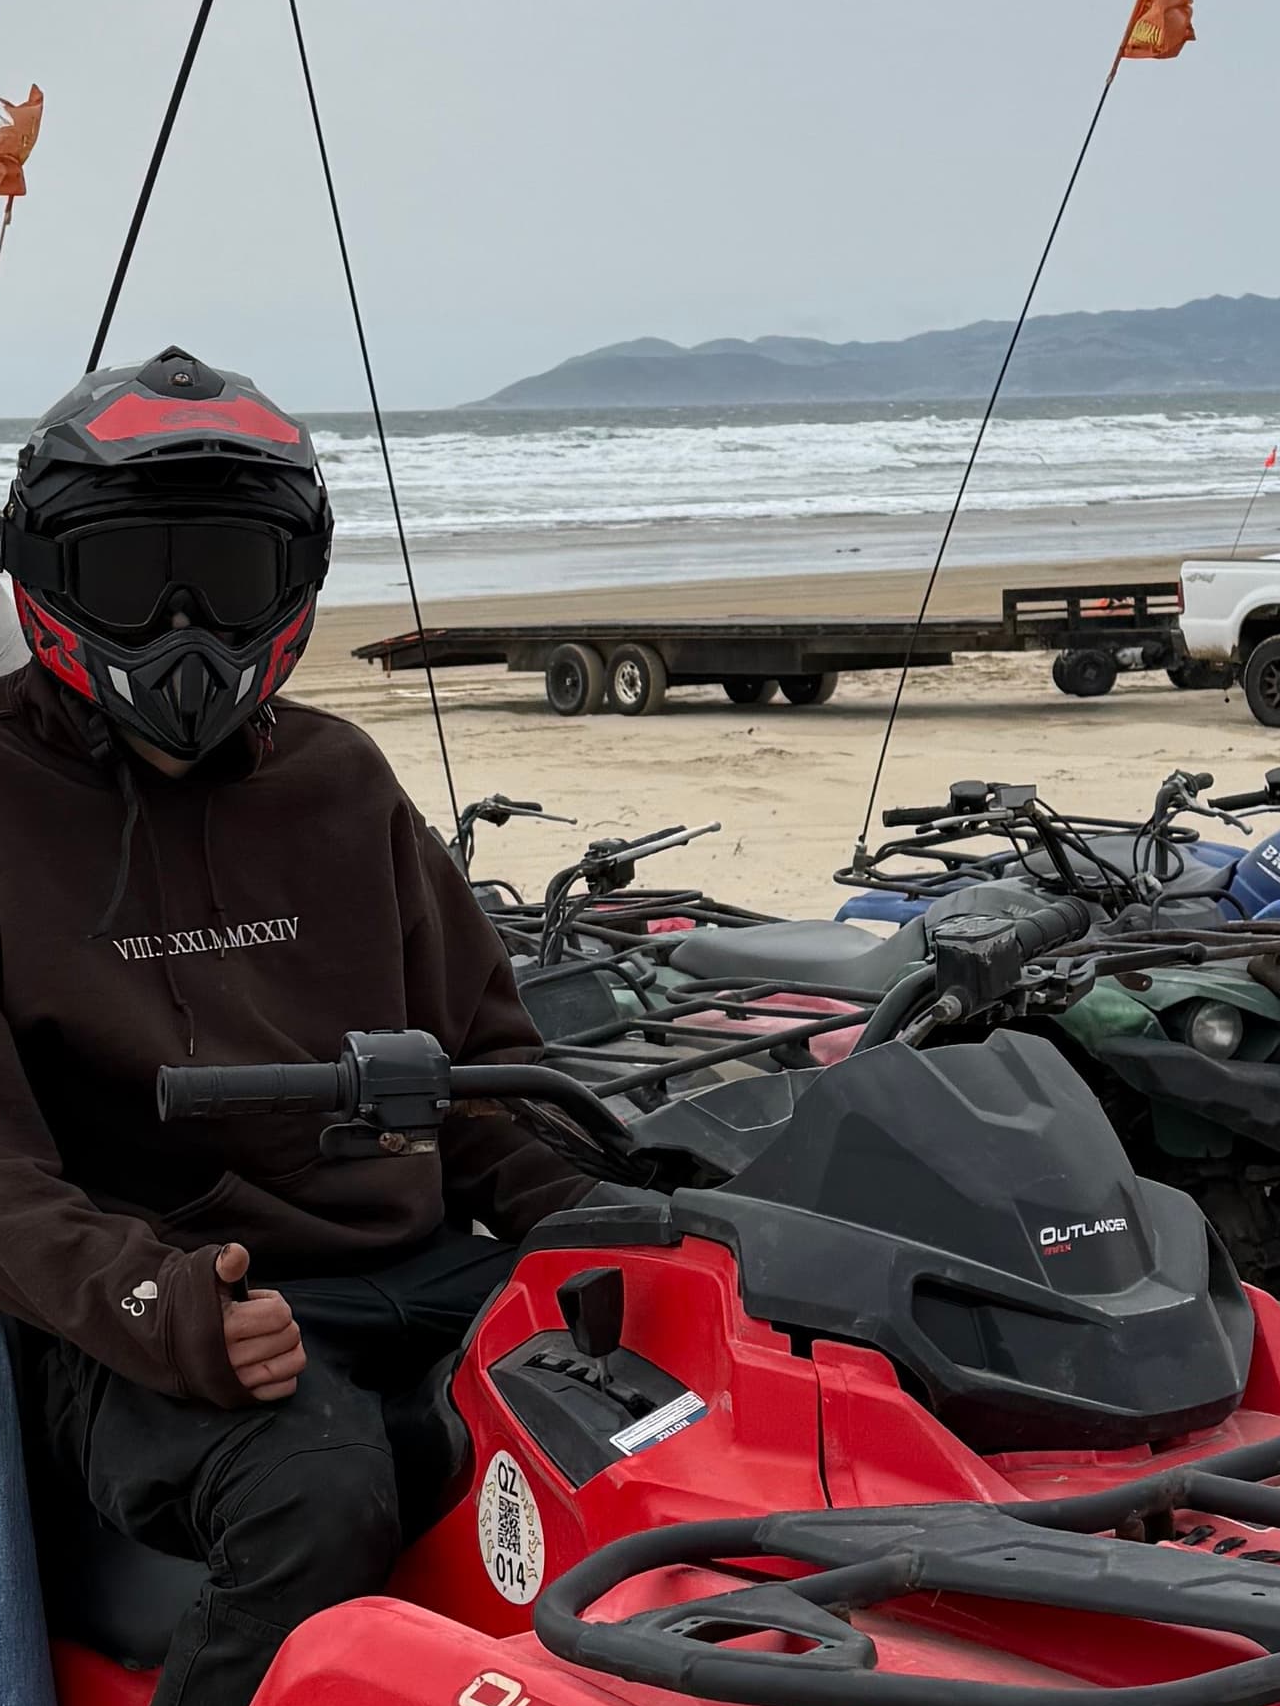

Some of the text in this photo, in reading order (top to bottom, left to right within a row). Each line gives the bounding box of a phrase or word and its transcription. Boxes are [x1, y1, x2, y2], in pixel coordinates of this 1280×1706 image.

[1040, 1218, 1128, 1246] OUTLANDER
[497, 1460, 519, 1497] QZ
[495, 1552, 526, 1591] 014
